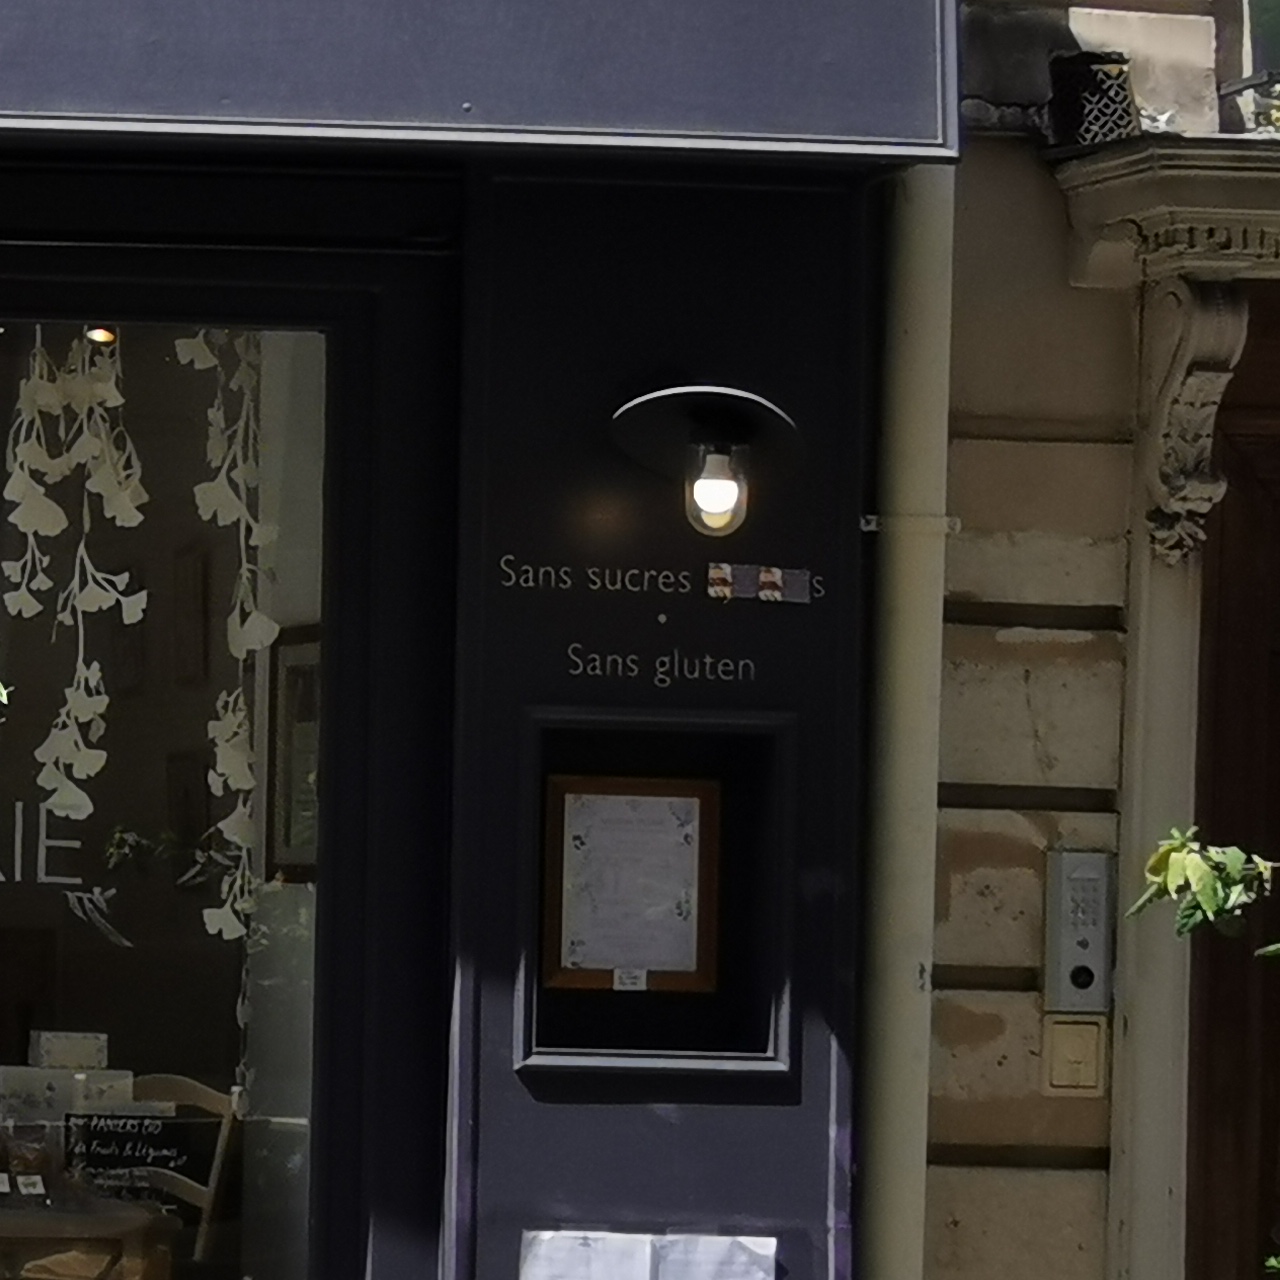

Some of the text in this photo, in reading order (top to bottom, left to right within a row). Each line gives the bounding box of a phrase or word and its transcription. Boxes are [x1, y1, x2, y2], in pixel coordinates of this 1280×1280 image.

[500, 554, 571, 588] Sans
[588, 565, 691, 593] sucres
[567, 643, 756, 687] Sans gluten
